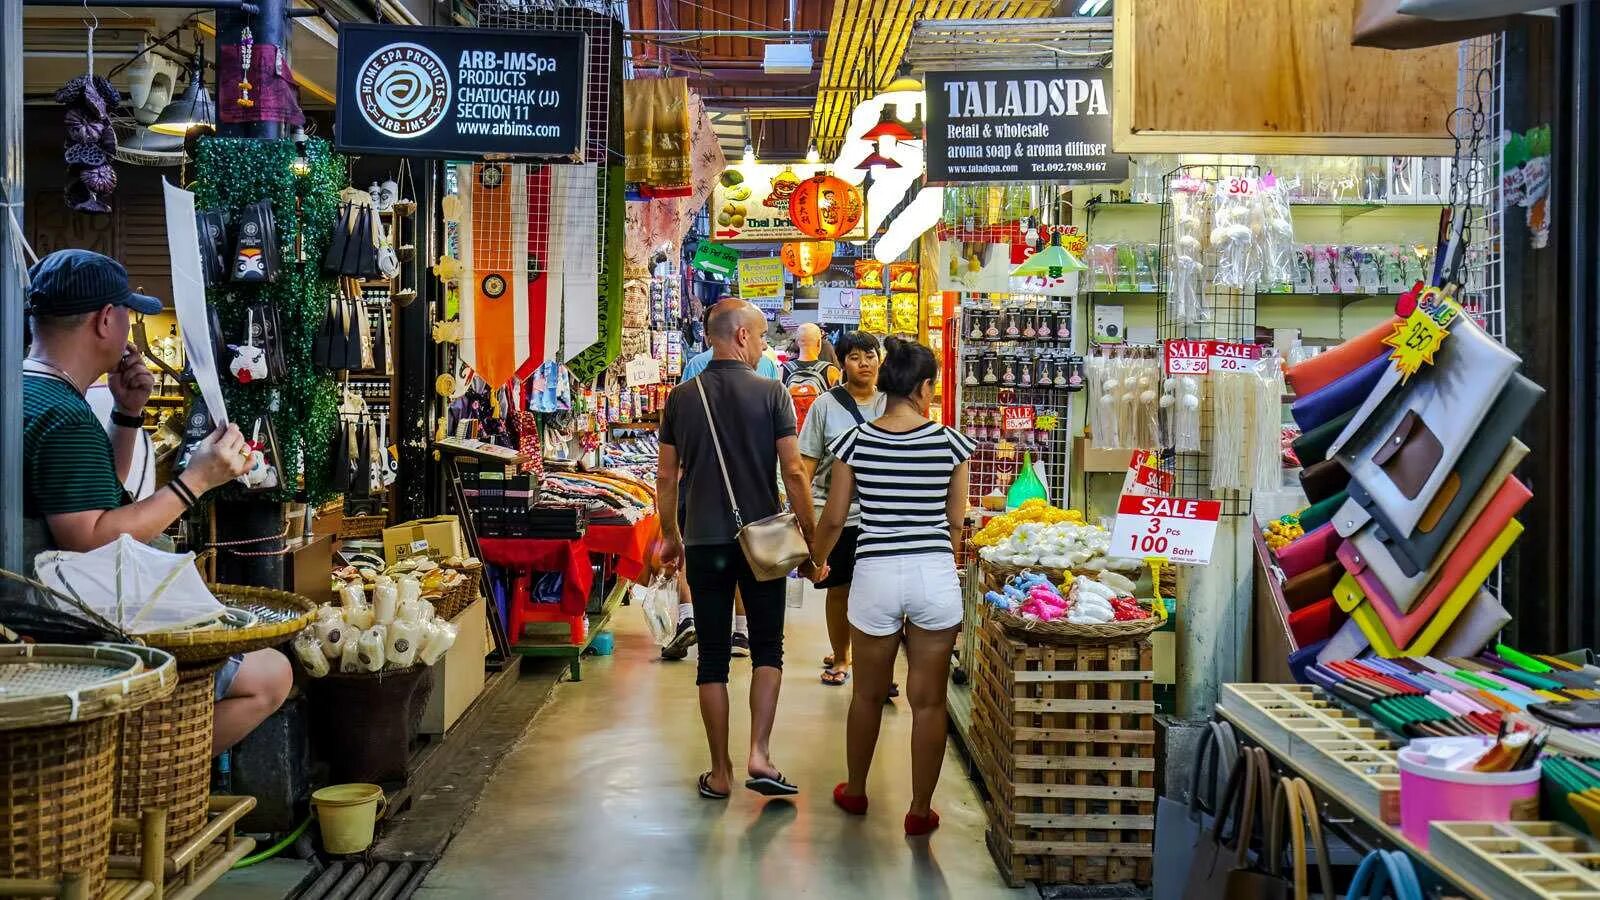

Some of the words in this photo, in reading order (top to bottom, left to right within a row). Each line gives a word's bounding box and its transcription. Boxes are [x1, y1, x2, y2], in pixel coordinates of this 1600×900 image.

[458, 50, 557, 76] ARB-IMSpa
[362, 61, 382, 93] HOME
[381, 49, 403, 65] SPA
[406, 49, 446, 97] PRODUCTS
[458, 69, 527, 87] PRODUCTS
[457, 87, 536, 105] CHATUCHAK
[538, 89, 560, 108] (JJ)
[944, 78, 1109, 118] TALADSPA
[456, 103, 511, 119] SECTION
[514, 105, 529, 120] 11
[377, 117, 427, 132] ARB-IMS
[456, 119, 560, 137] www.arbims.com
[947, 123, 980, 139] Retail
[982, 124, 992, 138] &
[994, 122, 1050, 139] wholesale
[947, 145, 984, 159] aroma
[986, 144, 1011, 160] soap
[1014, 143, 1024, 158] &
[1026, 143, 1062, 158] aroma
[1064, 141, 1107, 156] diffuser
[947, 163, 1019, 174] www.taladspa.com
[746, 218, 770, 228] Thai
[742, 275, 779, 284] MASSAGE
[1169, 341, 1208, 358] SALE
[1215, 345, 1251, 358] SALE
[1005, 407, 1031, 419] SALE
[1139, 497, 1199, 518] SALE
[1147, 517, 1161, 534] 3
[1130, 534, 1168, 554] 100
[1172, 547, 1194, 556] Baht
